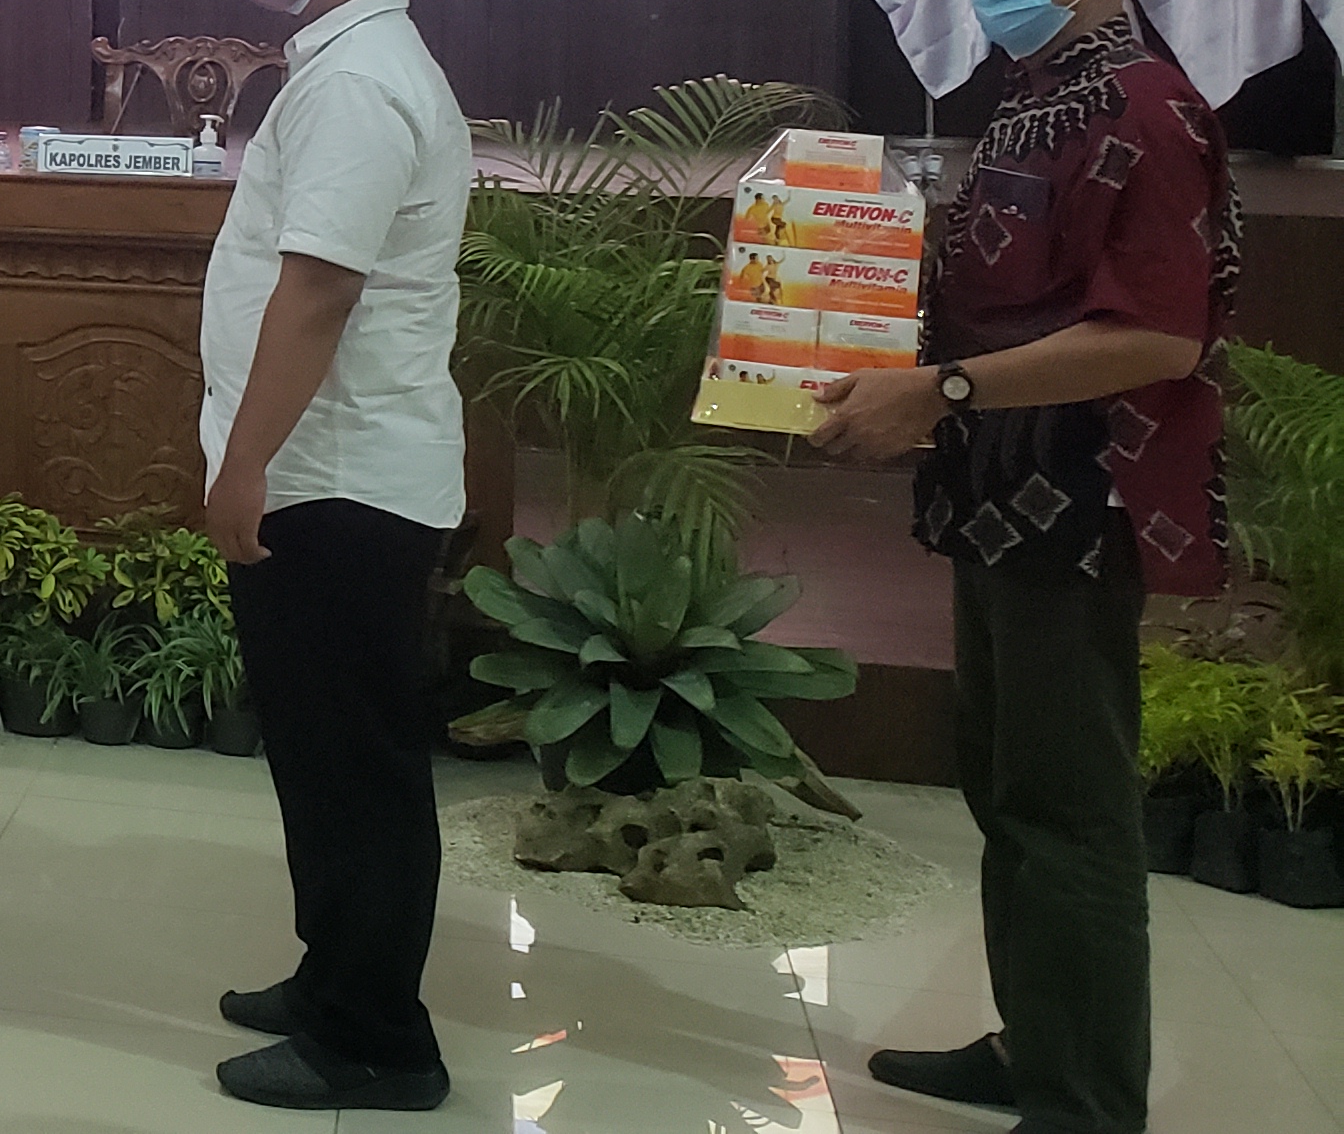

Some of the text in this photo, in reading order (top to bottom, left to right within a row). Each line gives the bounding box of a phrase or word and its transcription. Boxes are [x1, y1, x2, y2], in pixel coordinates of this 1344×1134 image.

[48, 151, 181, 172] KAPOLRES JEMBER
[812, 201, 914, 224] ENERVON-C
[807, 260, 909, 284] ENERVON-C
